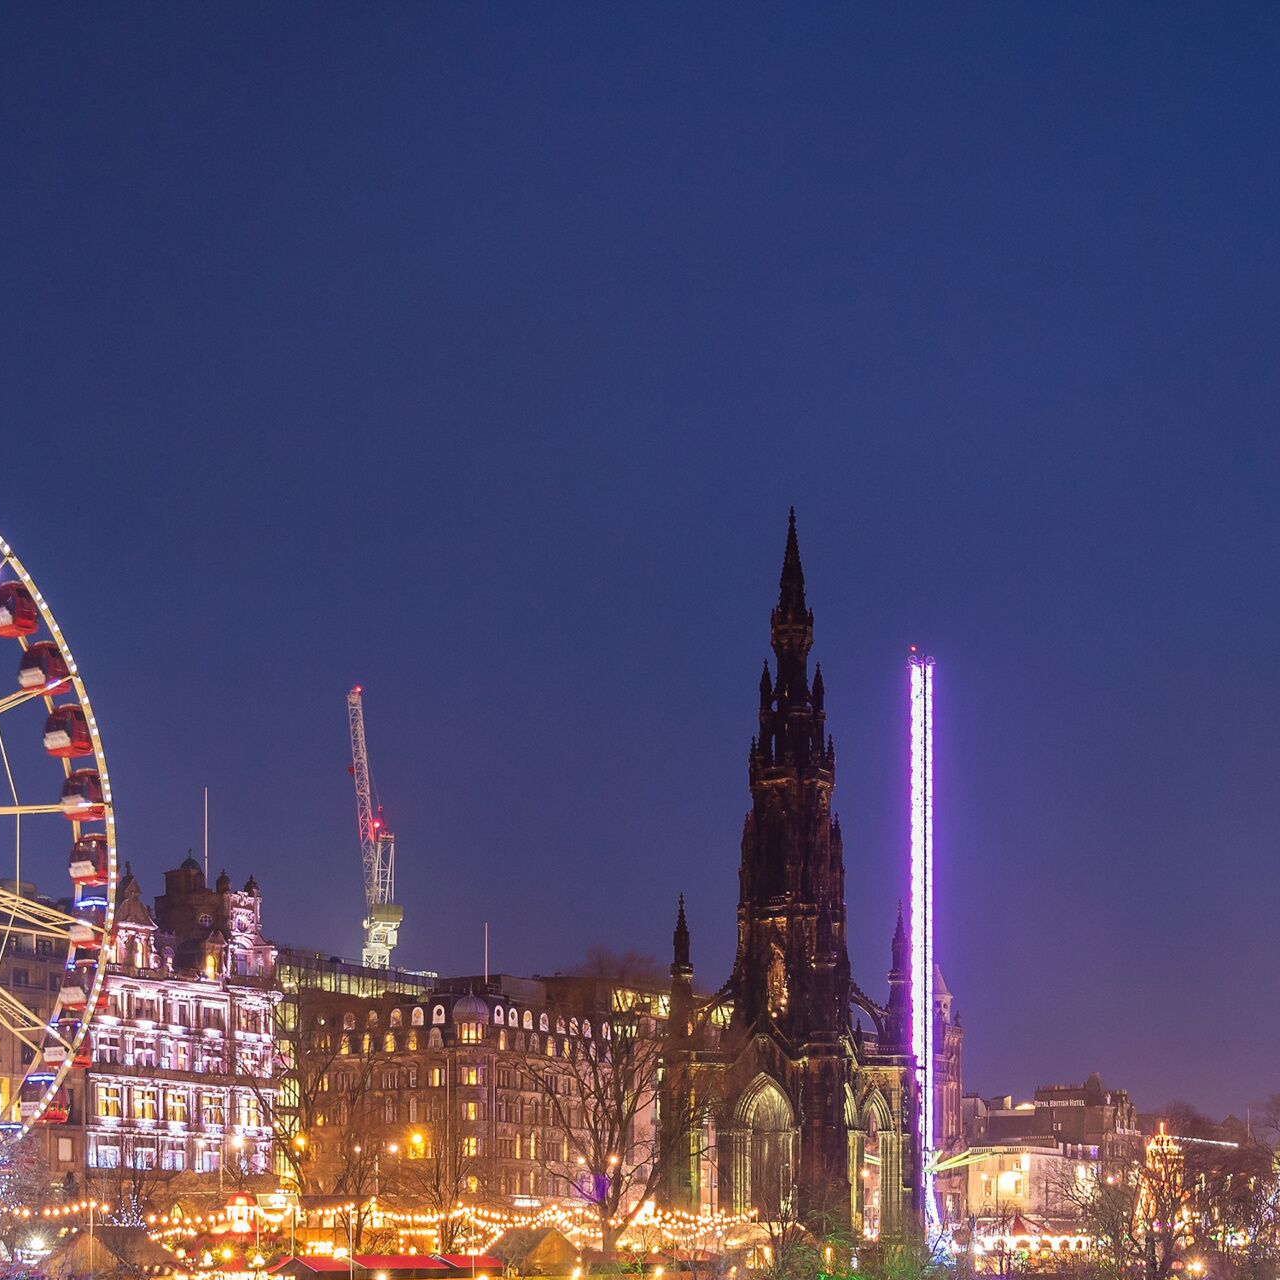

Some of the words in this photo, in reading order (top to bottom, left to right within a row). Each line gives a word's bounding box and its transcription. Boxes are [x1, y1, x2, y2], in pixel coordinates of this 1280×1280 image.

[1034, 1100, 1049, 1108] ROYAL
[1050, 1099, 1069, 1107] BRITISH
[1070, 1098, 1085, 1107] HOTEL
